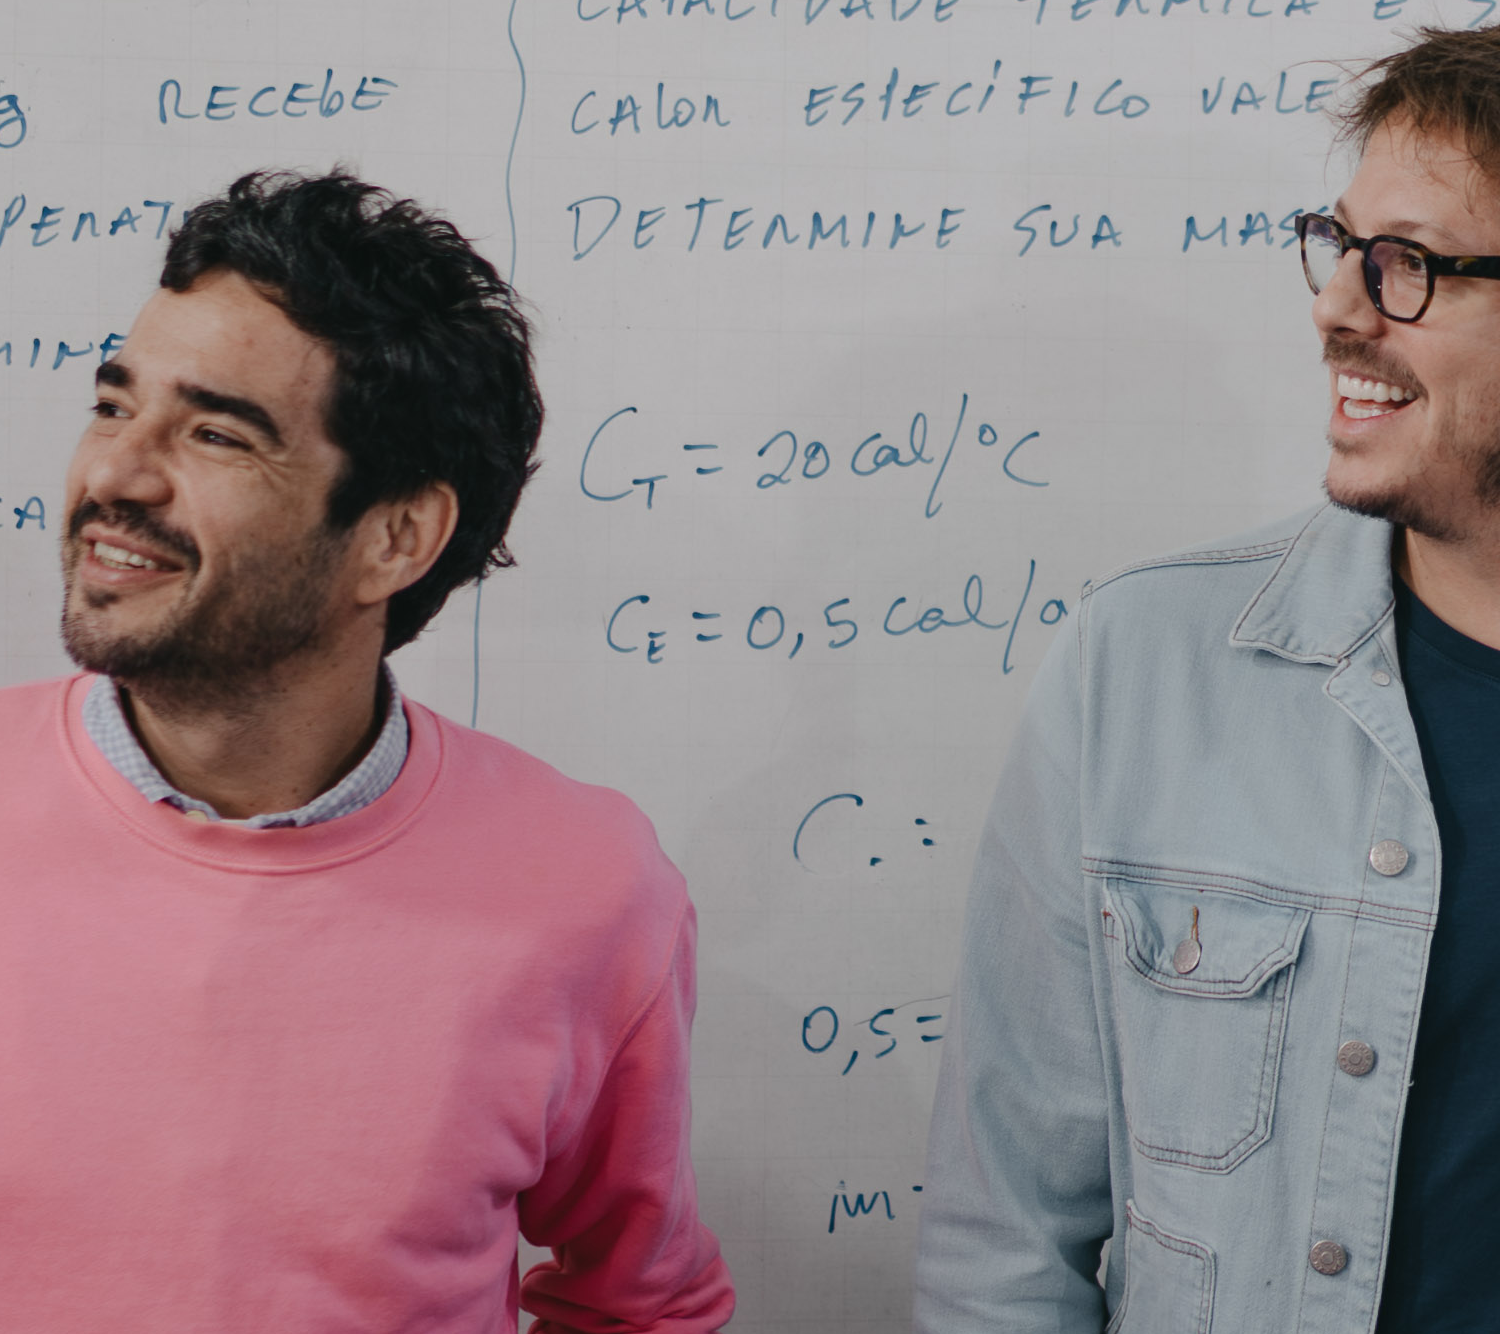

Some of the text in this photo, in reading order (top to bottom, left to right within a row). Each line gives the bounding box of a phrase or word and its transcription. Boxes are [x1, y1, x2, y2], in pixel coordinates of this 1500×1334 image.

[1202, 70, 1343, 116] VALE
[566, 195, 966, 262] DETERMINE
[1012, 204, 1123, 257] SUA
